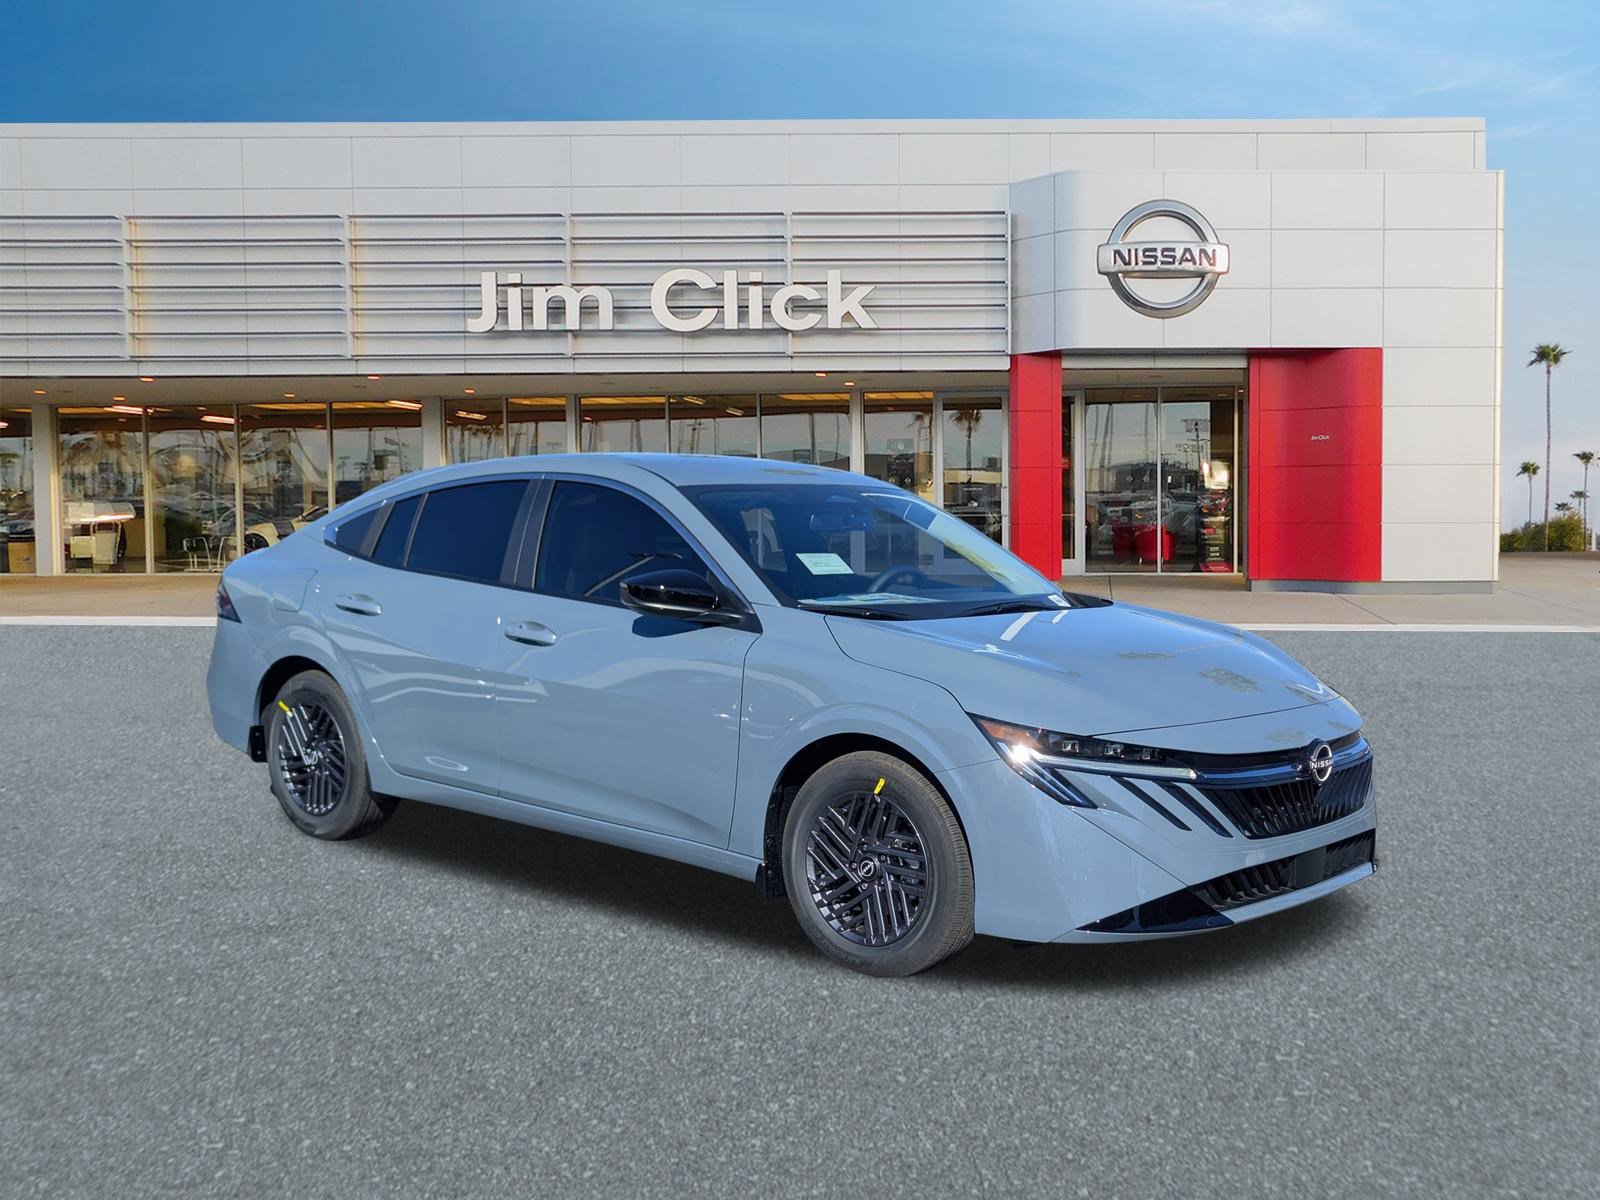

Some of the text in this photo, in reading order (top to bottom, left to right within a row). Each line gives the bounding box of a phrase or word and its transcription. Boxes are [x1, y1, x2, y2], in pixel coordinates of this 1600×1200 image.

[1112, 247, 1217, 266] NISSAN
[467, 269, 879, 333] Jim Click
